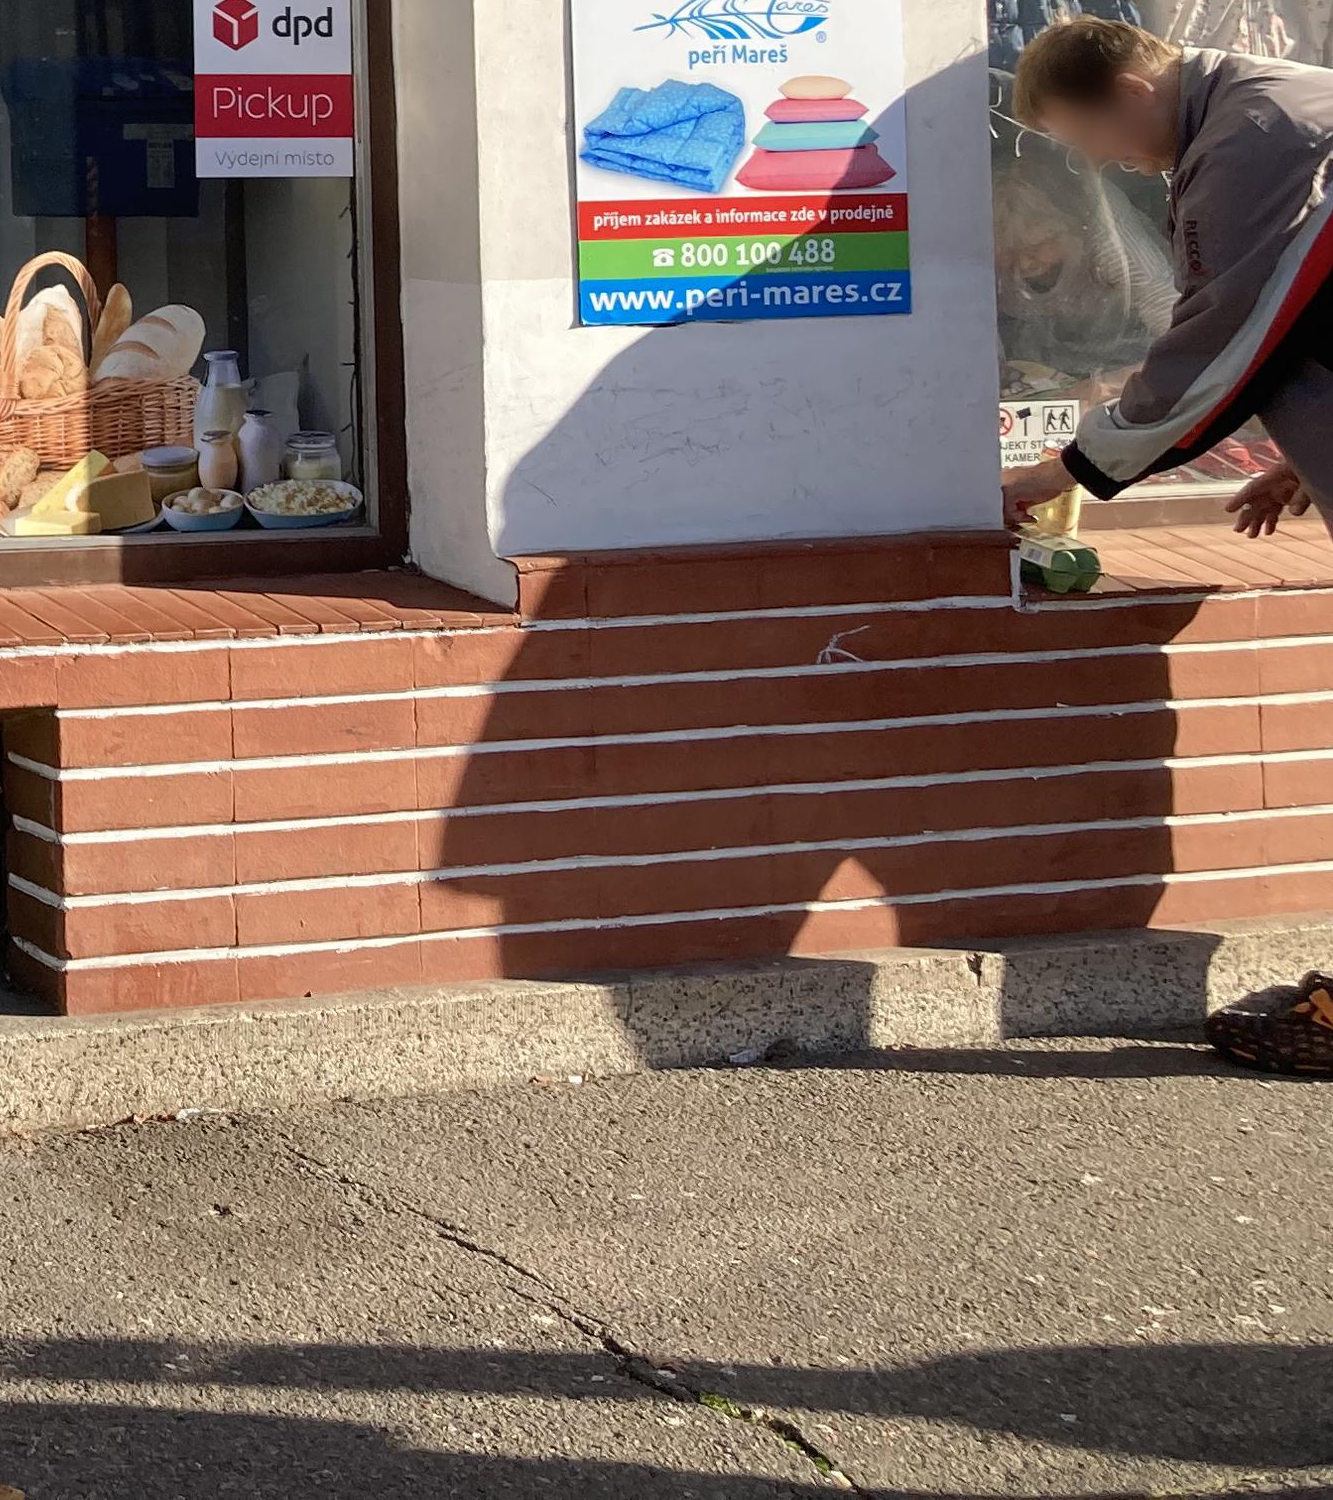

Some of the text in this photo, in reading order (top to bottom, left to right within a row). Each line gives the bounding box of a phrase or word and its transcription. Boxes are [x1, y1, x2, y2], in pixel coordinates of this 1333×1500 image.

[272, 6, 333, 45] dpd
[688, 44, 788, 69] peří Mareš
[213, 86, 333, 126] Pickup
[215, 150, 335, 169] Výdejní místo
[593, 205, 894, 231] příjem zakázek a informace zde v prodejně
[681, 238, 835, 267] 800 100 488
[589, 282, 902, 316] www.peri-mares.cz
